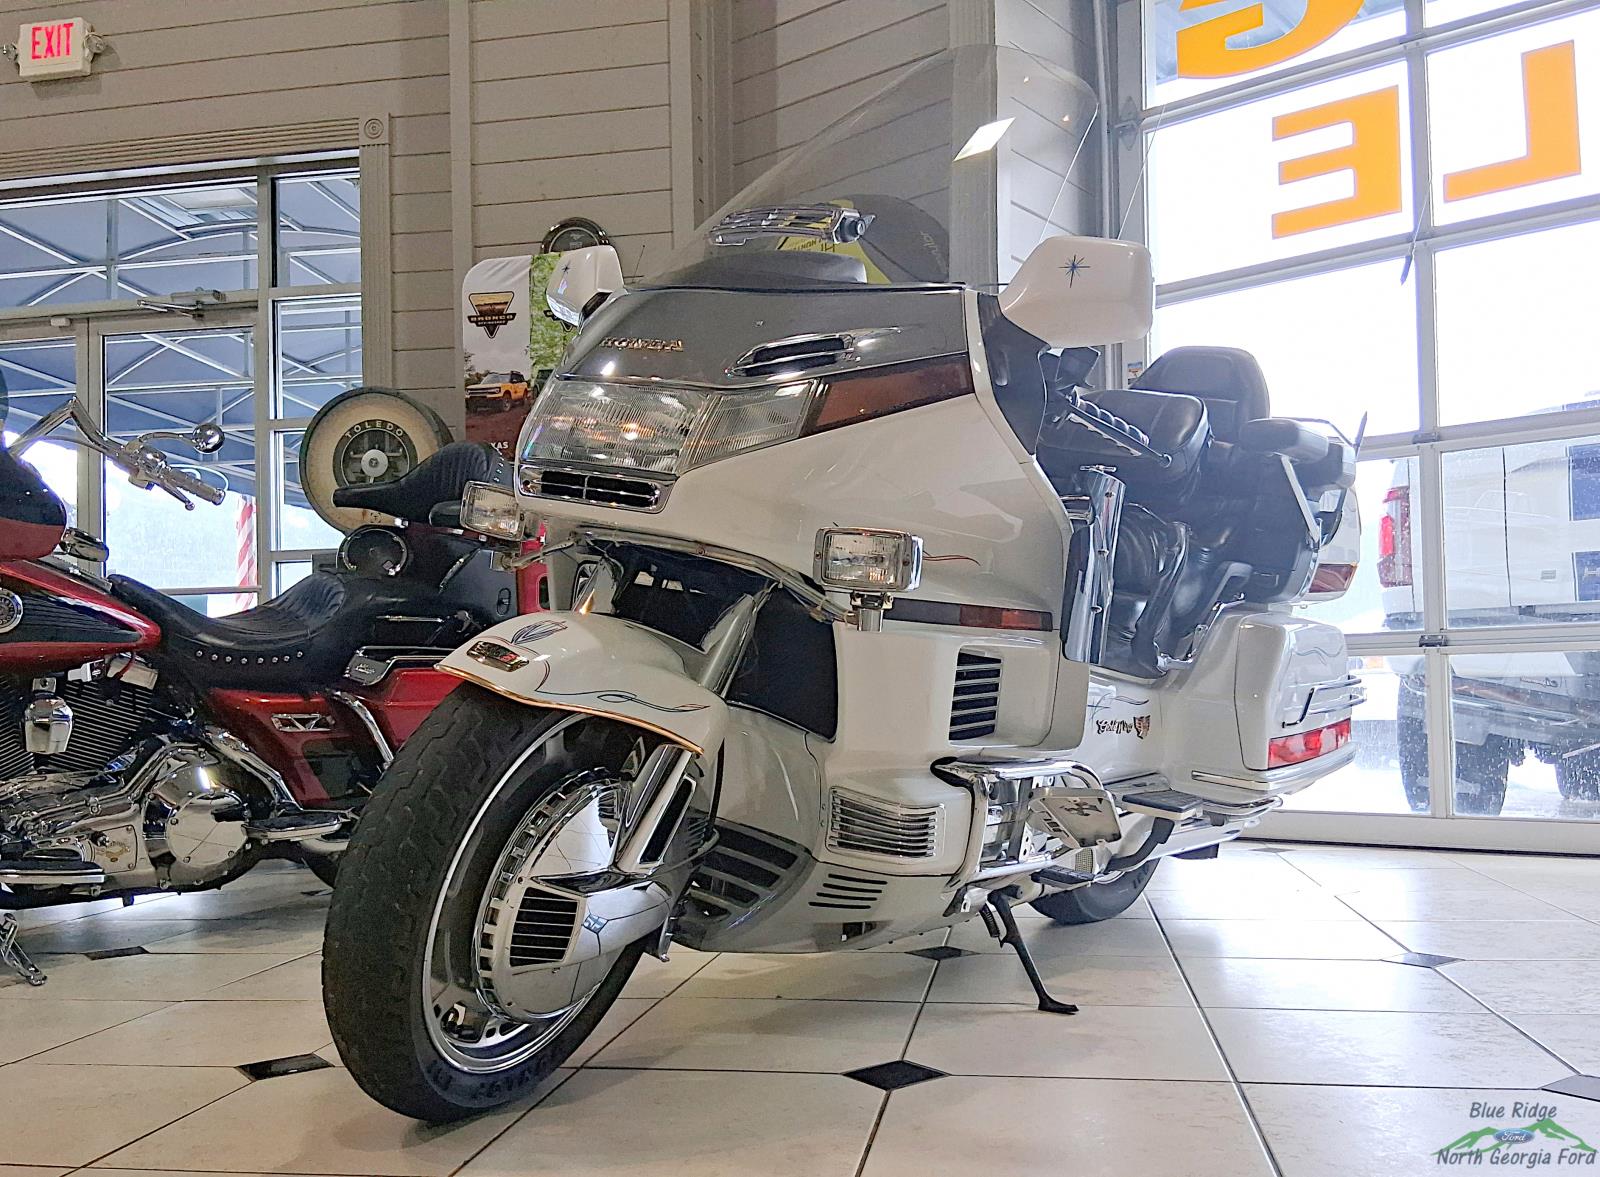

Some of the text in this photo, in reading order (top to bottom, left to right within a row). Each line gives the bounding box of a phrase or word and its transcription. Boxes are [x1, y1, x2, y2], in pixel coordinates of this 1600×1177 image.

[31, 22, 74, 60] EXIT
[470, 314, 513, 322] BRONCO
[344, 420, 404, 439] TOLEDO
